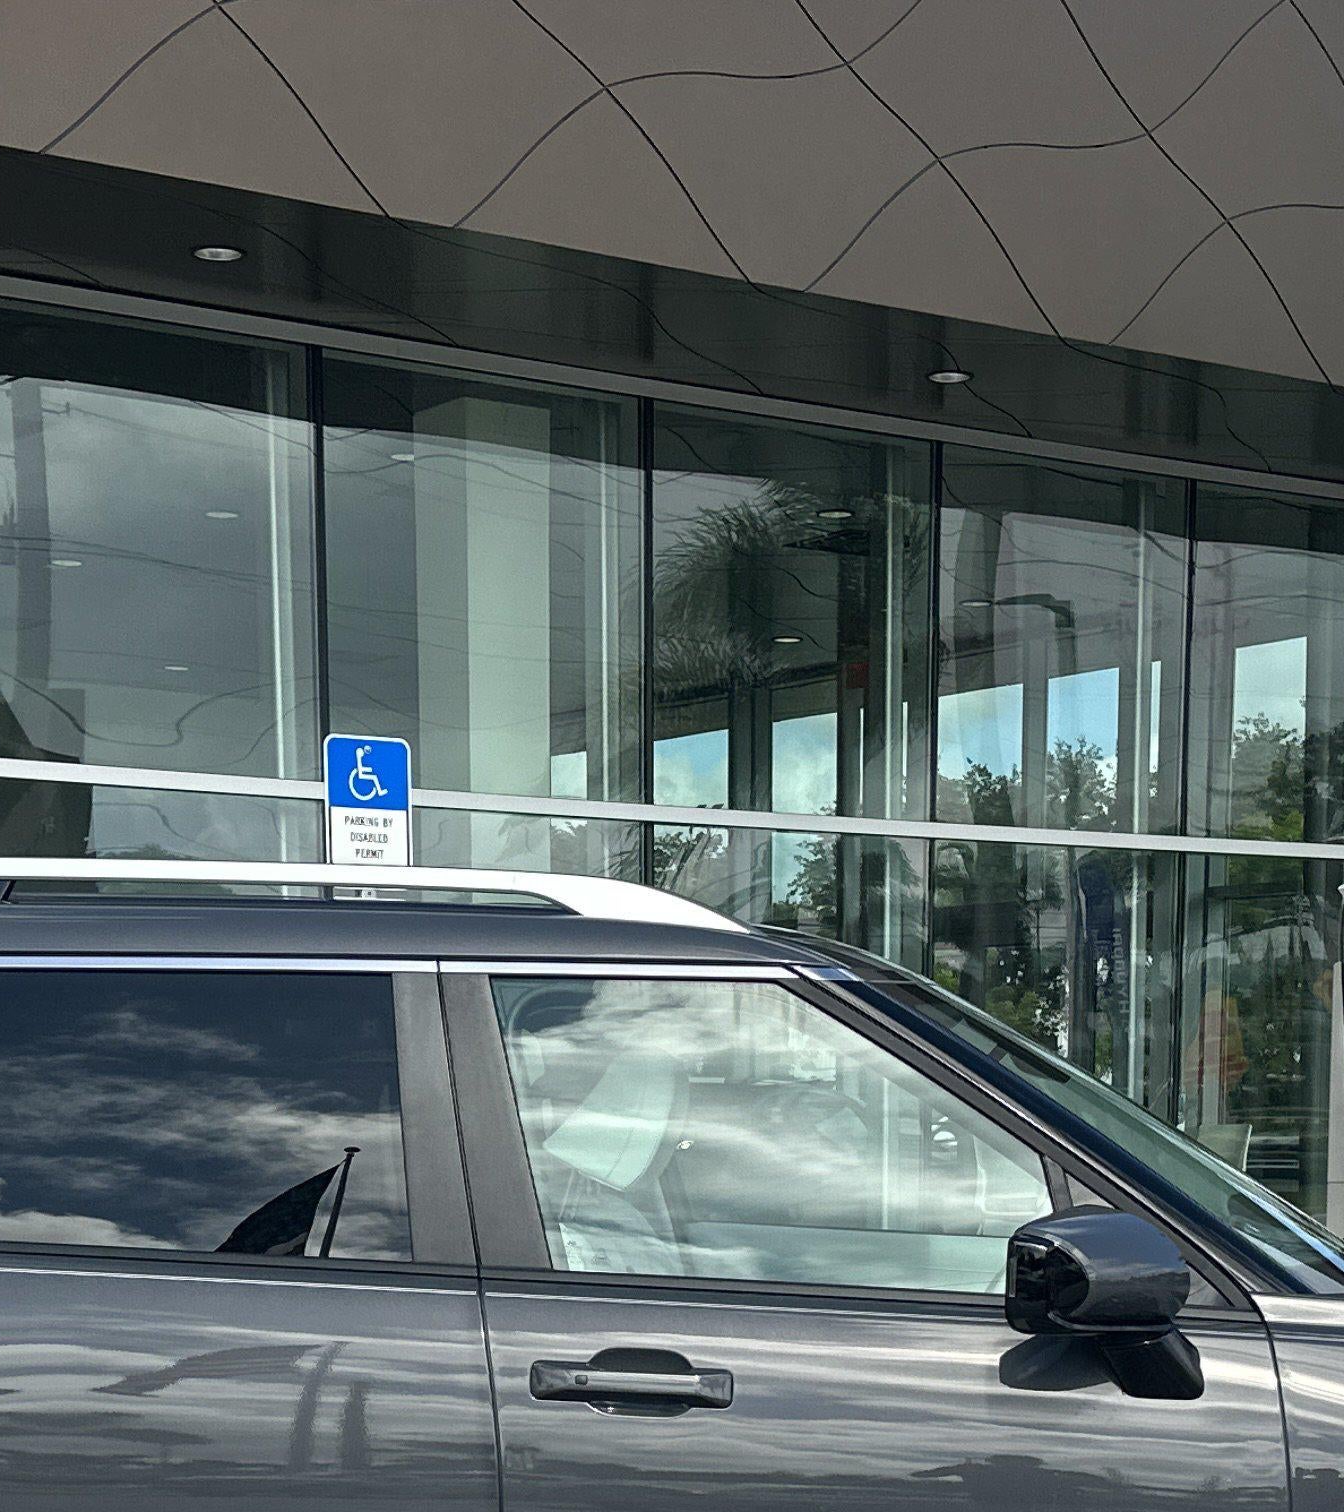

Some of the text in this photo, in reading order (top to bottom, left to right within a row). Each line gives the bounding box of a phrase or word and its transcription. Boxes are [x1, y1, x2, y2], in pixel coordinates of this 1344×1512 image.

[344, 815, 393, 828] PARKING BY
[350, 831, 388, 843] DISABLED
[355, 848, 384, 860] PERMIT
